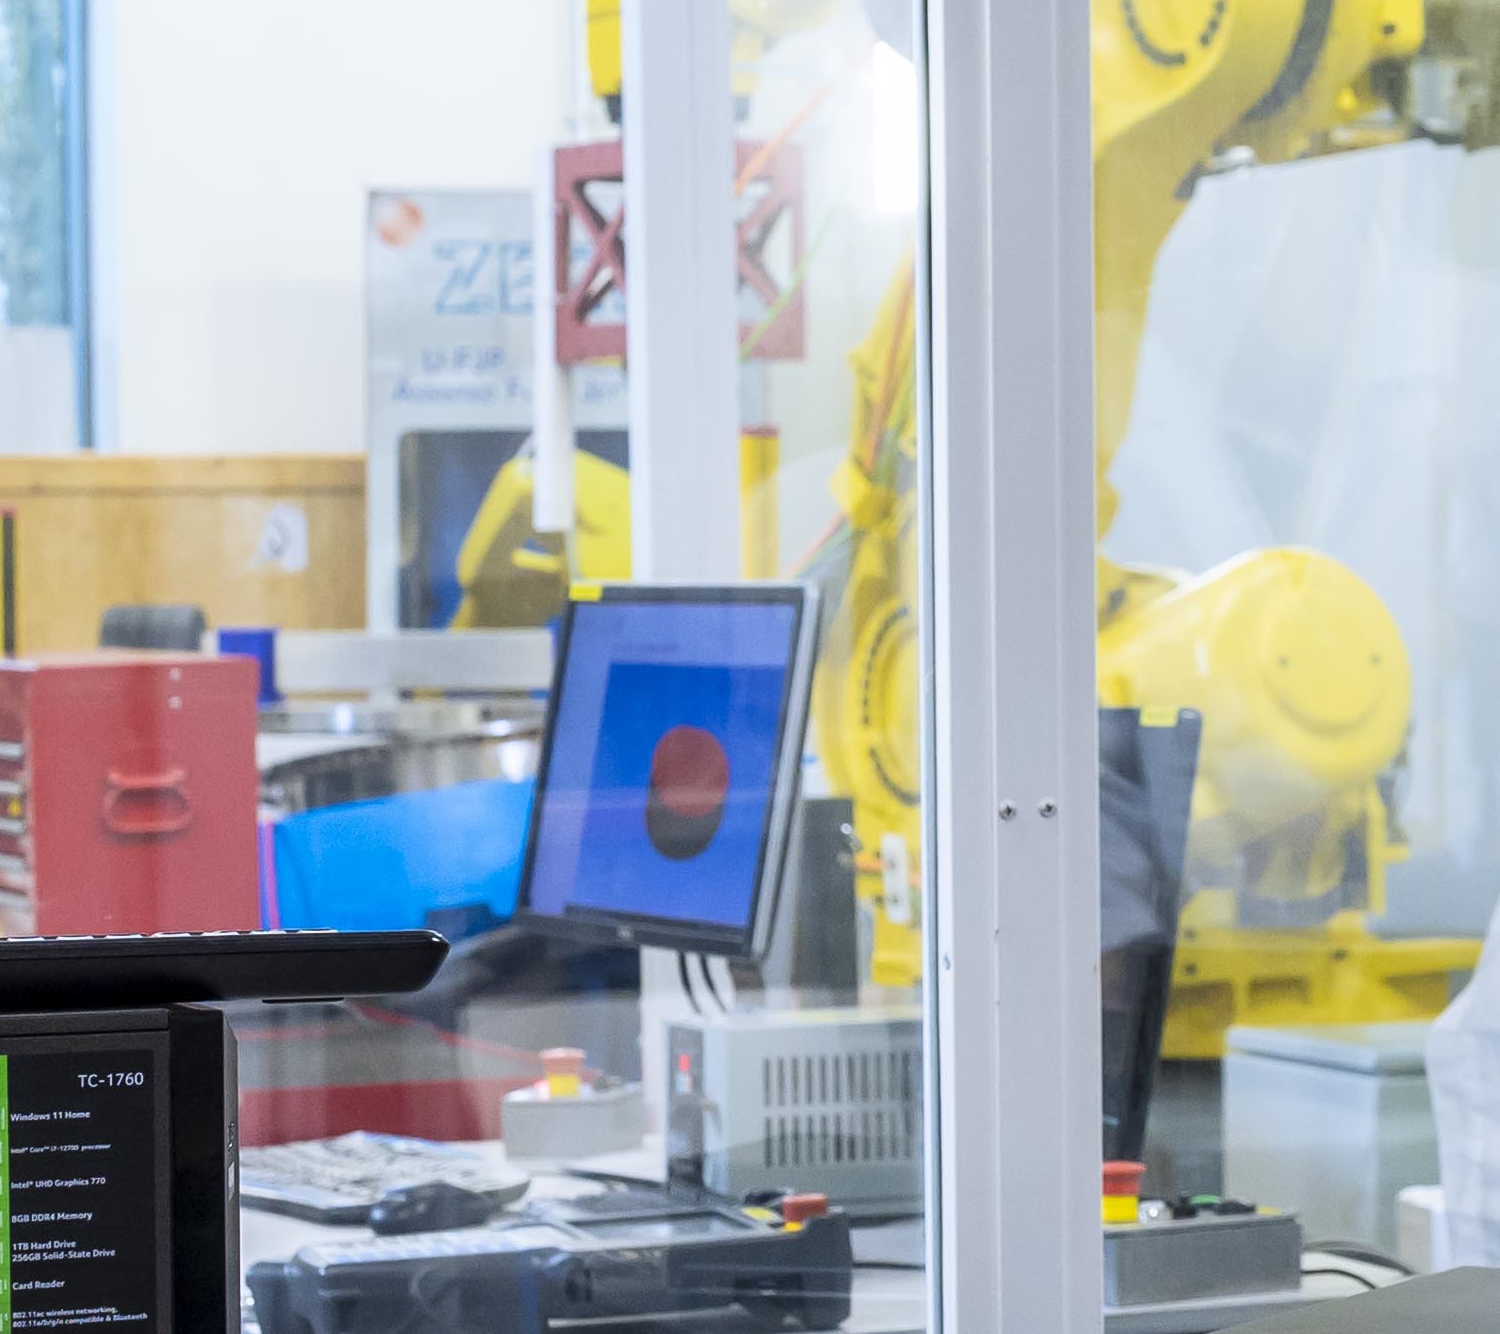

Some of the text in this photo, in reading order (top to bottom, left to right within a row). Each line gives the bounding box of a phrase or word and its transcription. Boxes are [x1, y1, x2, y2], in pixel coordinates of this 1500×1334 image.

[78, 1072, 144, 1088] TC-1760
[11, 1110, 91, 1122] Windows 11 Home
[35, 1179, 53, 1188] UHD
[54, 1178, 89, 1188] Graphics
[90, 1176, 106, 1185] 770
[11, 1214, 30, 1223] 8GB
[31, 1213, 55, 1222] DDR4
[56, 1212, 93, 1222] Memory
[12, 1239, 77, 1251] 1TB Hard Drive
[12, 1253, 41, 1262] 256GB
[42, 1250, 91, 1260] Solid-State
[92, 1248, 116, 1257] Drive
[12, 1281, 33, 1291] Card
[34, 1278, 65, 1289] Reader
[45, 1308, 75, 1317] wireless
[64, 1315, 104, 1325] compatible
[112, 1312, 148, 1321] Bluetooth
